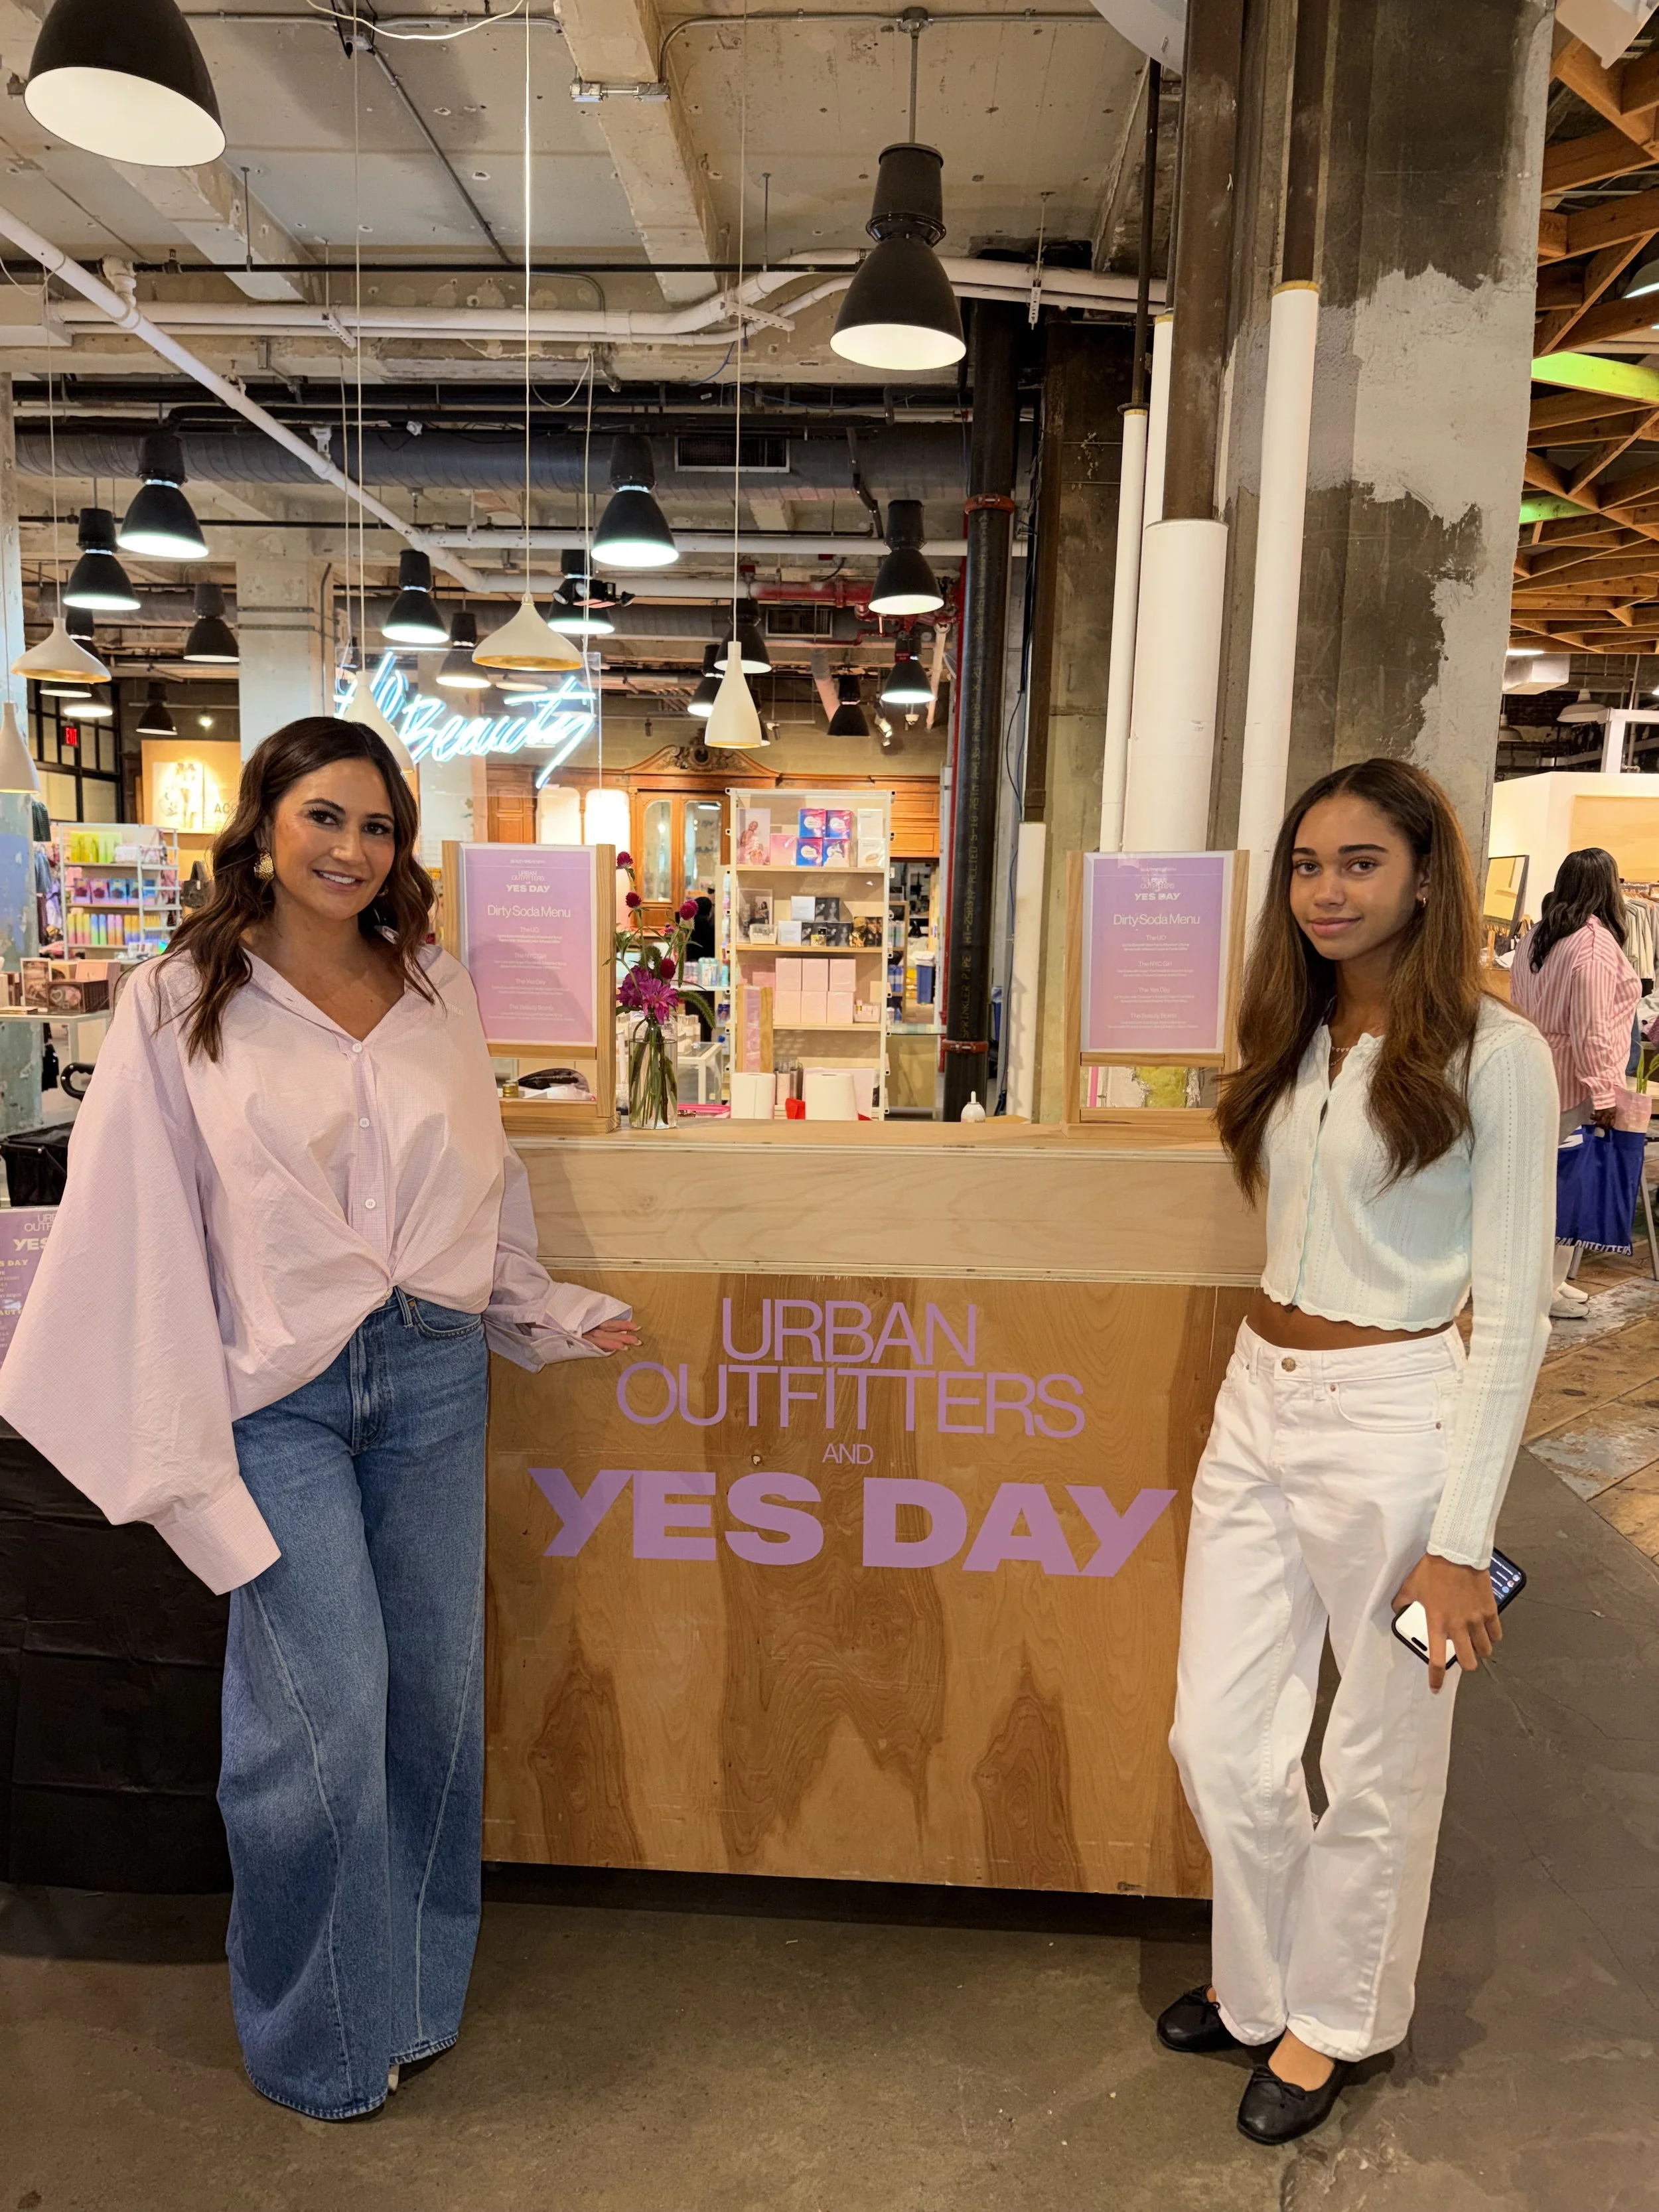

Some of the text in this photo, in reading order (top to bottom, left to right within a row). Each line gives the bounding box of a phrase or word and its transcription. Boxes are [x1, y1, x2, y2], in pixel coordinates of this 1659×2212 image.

[399, 675, 597, 789] Beauty
[967, 846, 978, 883] ALLIED
[506, 884, 528, 893] YES
[488, 905, 571, 919] Dirty Soda Menu
[1113, 914, 1200, 927] Dirty Soda Menu
[962, 955, 972, 980] PIPE
[960, 985, 970, 1039] SPRINKLER
[722, 1297, 977, 1367] URBAN
[616, 1361, 1086, 1438] OUTFITTERS
[822, 1442, 874, 1465] AND
[530, 1466, 1179, 1578] YES DAY
